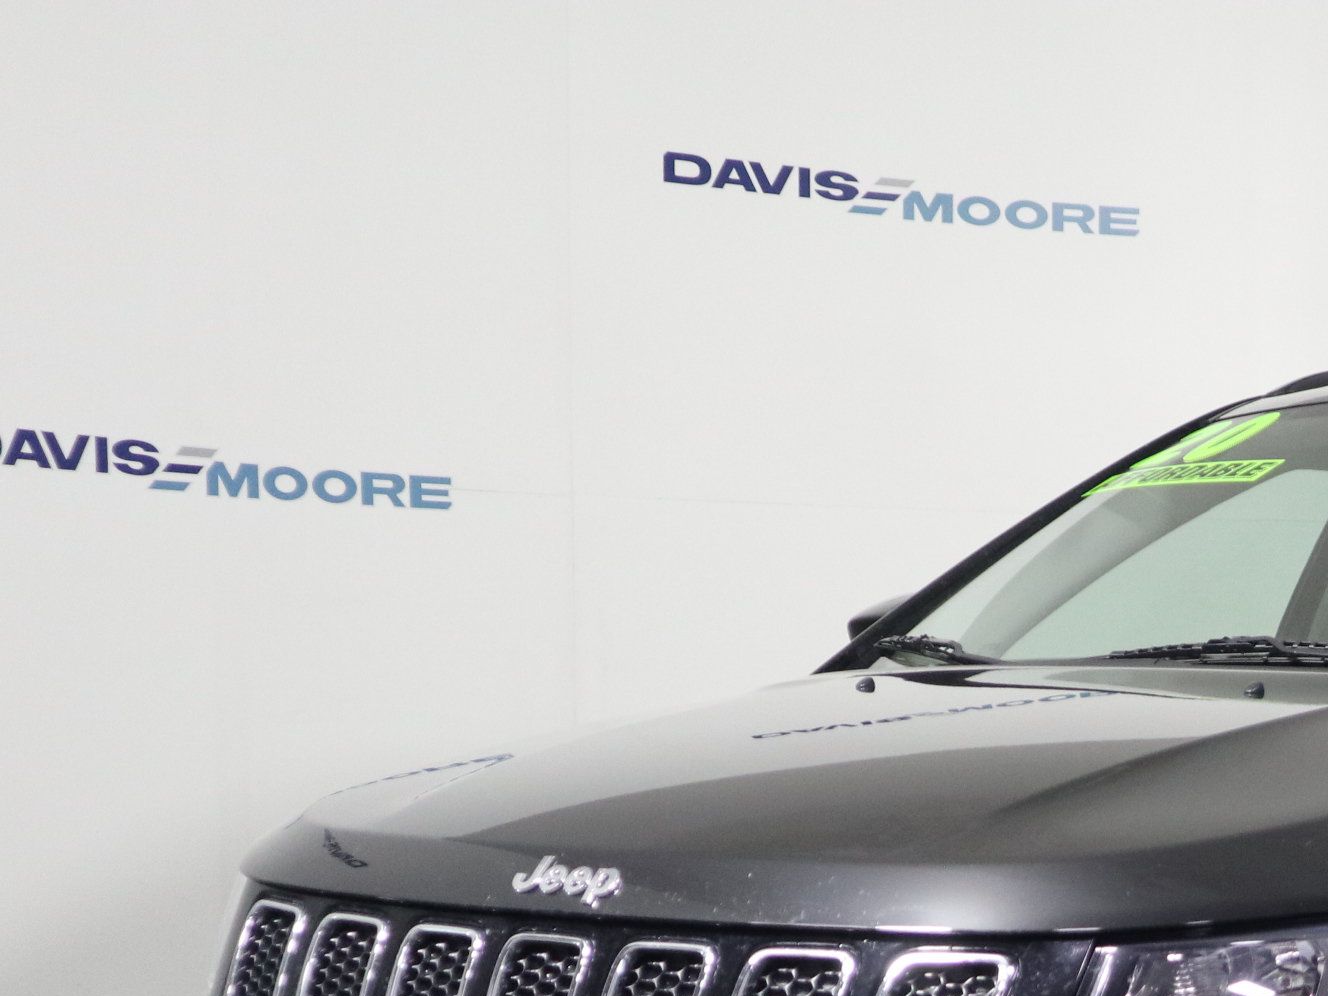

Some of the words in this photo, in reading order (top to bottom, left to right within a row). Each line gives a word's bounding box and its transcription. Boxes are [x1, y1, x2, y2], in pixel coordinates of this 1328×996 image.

[663, 151, 859, 201] DAVIS
[903, 190, 1140, 237] MOORE
[0, 428, 160, 476] AVIS
[206, 461, 452, 510] MOORE
[1103, 460, 1279, 488] FORDABLE
[512, 855, 623, 909] Jeep
